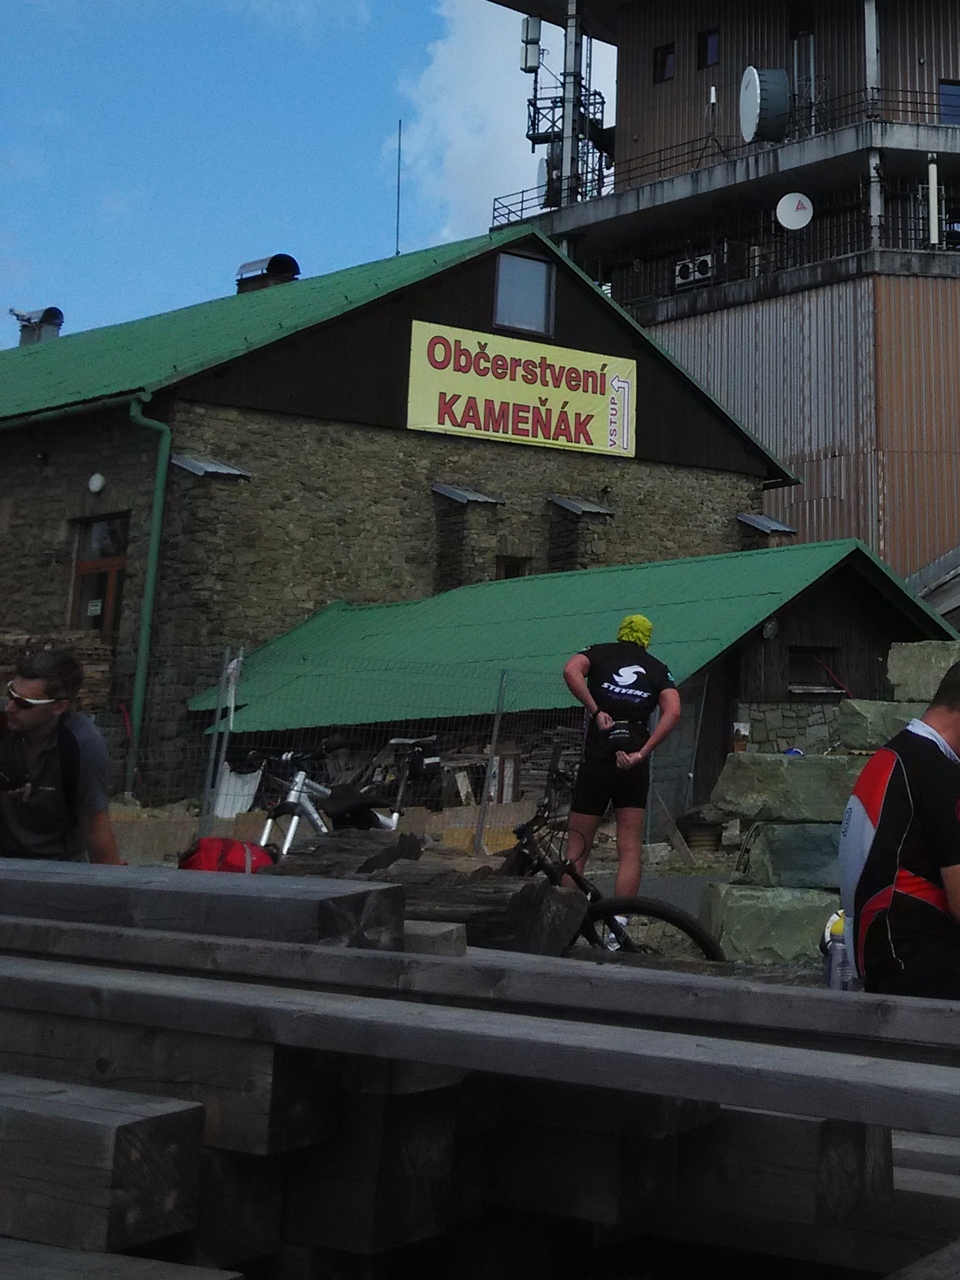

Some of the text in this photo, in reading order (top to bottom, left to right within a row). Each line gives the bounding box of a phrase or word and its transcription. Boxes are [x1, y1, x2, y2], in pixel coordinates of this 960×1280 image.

[427, 336, 607, 395] Občerstvení
[438, 392, 594, 445] KAMEŇÁK
[608, 396, 618, 447] VSTUP
[602, 682, 651, 698] STEVENS
